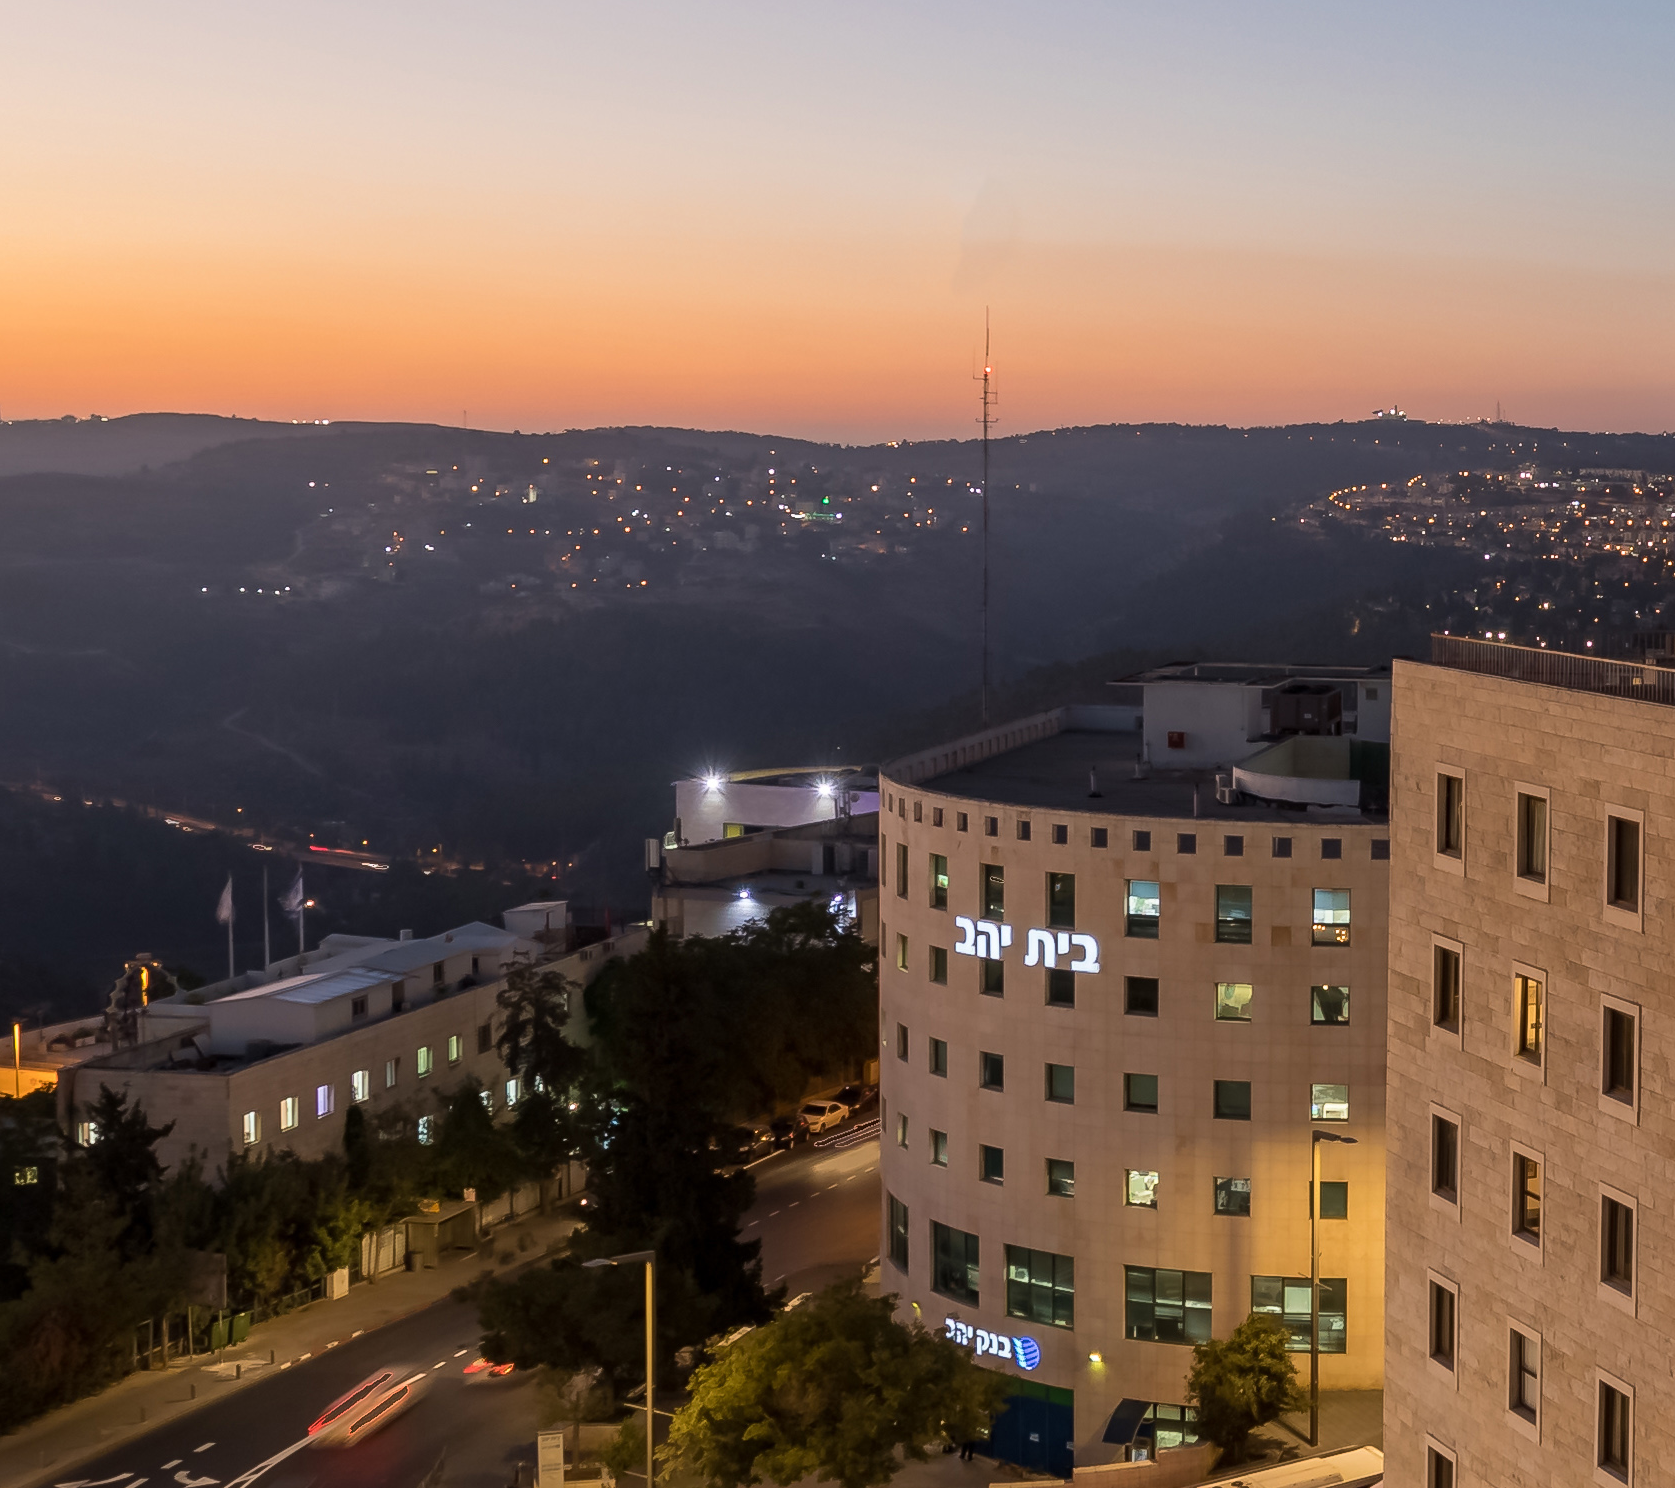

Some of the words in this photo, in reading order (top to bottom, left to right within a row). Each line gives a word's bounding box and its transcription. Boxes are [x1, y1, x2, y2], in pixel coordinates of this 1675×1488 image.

[954, 915, 1013, 960] יהב
[1024, 928, 1100, 974] בית
[976, 1328, 1013, 1359] בנק
